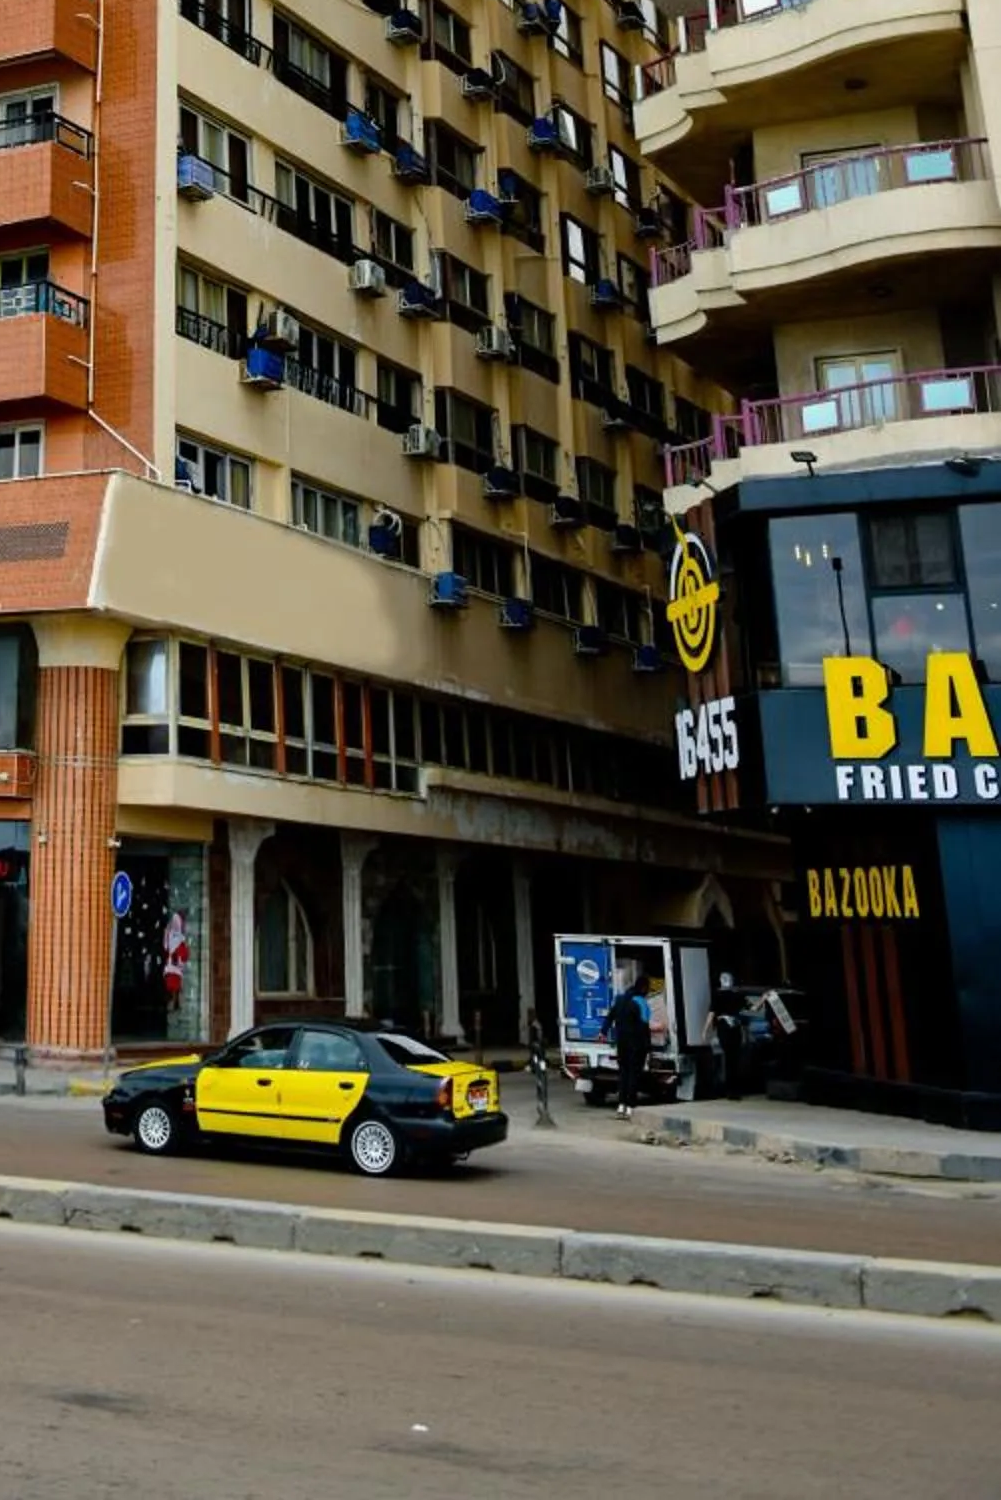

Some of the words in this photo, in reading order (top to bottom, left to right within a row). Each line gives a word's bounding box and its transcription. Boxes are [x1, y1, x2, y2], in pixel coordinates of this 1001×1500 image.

[675, 696, 739, 781] 16455
[835, 763, 958, 800] FRIED
[807, 864, 920, 918] BAZOOKA
